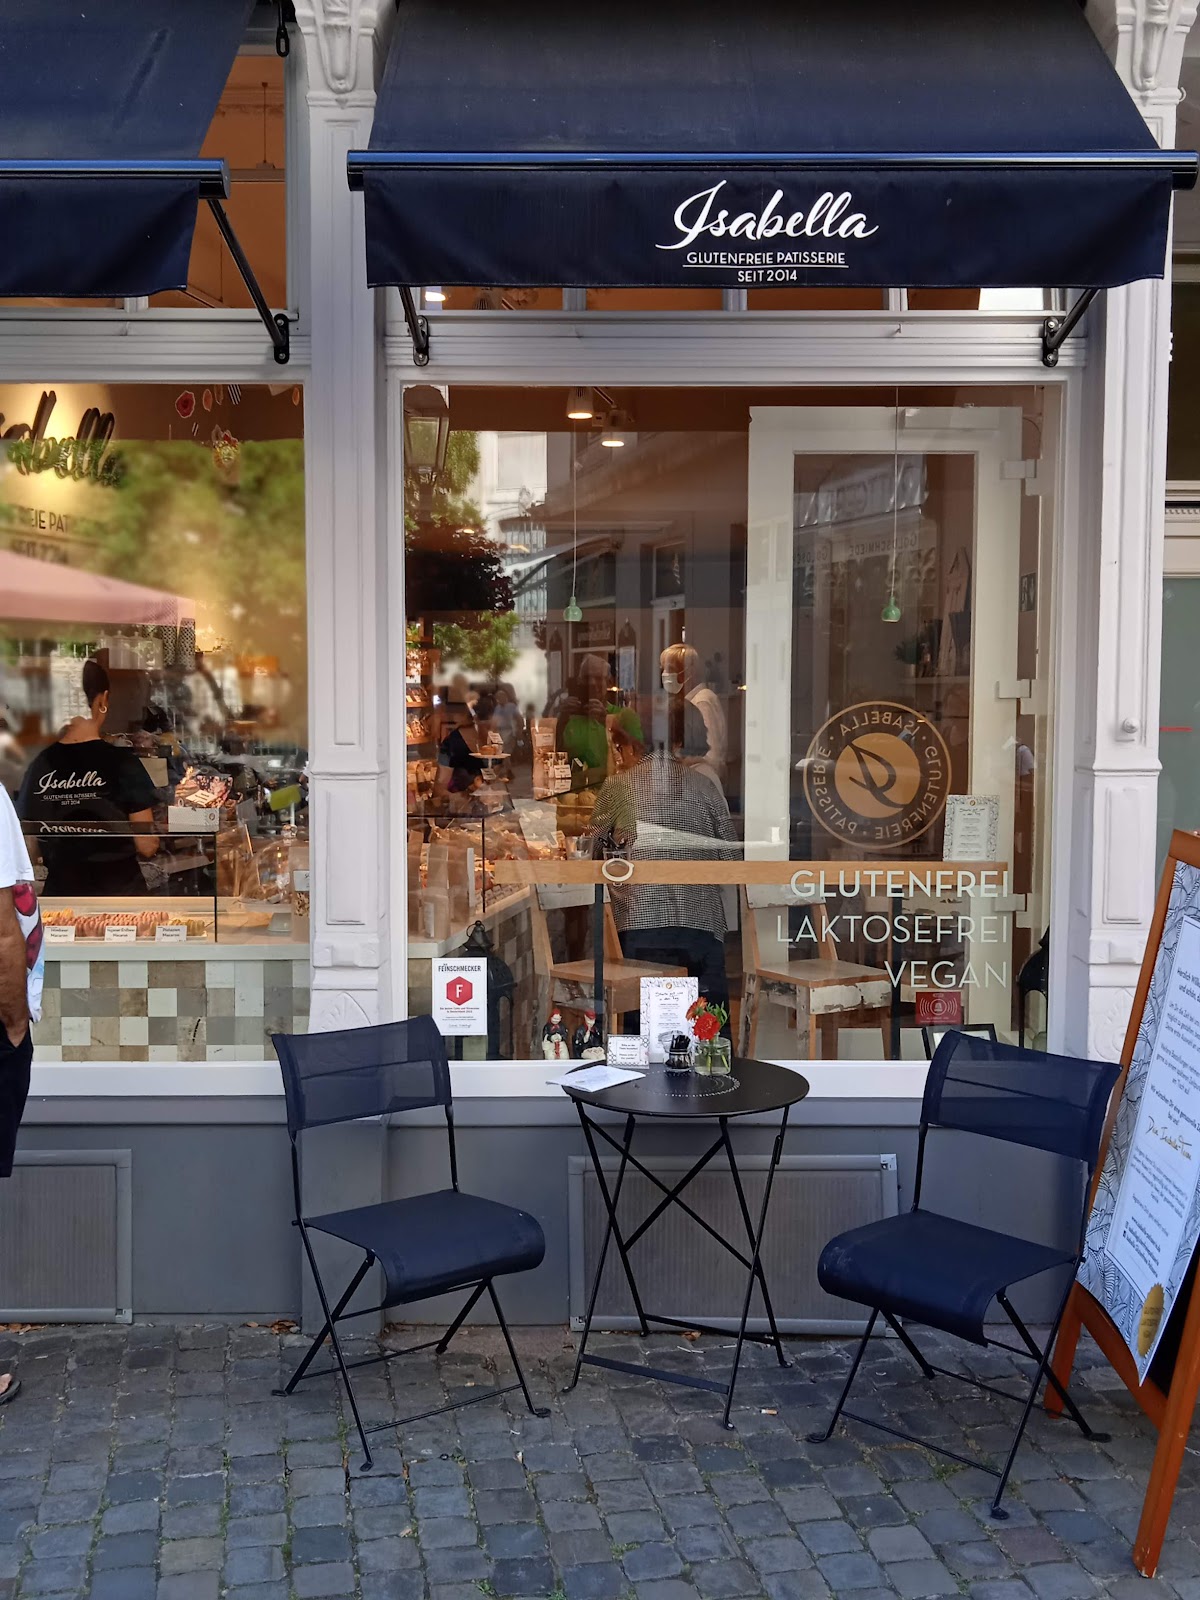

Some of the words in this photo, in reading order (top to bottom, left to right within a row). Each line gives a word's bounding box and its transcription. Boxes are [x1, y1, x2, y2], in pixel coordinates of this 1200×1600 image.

[655, 179, 879, 250] Isabella
[686, 251, 774, 265] GLUTENFREIE
[776, 251, 846, 265] PATISSERIE
[737, 270, 765, 282] SEIT
[766, 269, 798, 282] 2014
[33, 769, 107, 795] Isabella
[790, 870, 1008, 898] GLUTENFREI
[777, 915, 1007, 943] LAKTOSEFREI
[884, 960, 1007, 989] VEGAN
[455, 984, 464, 999] F
